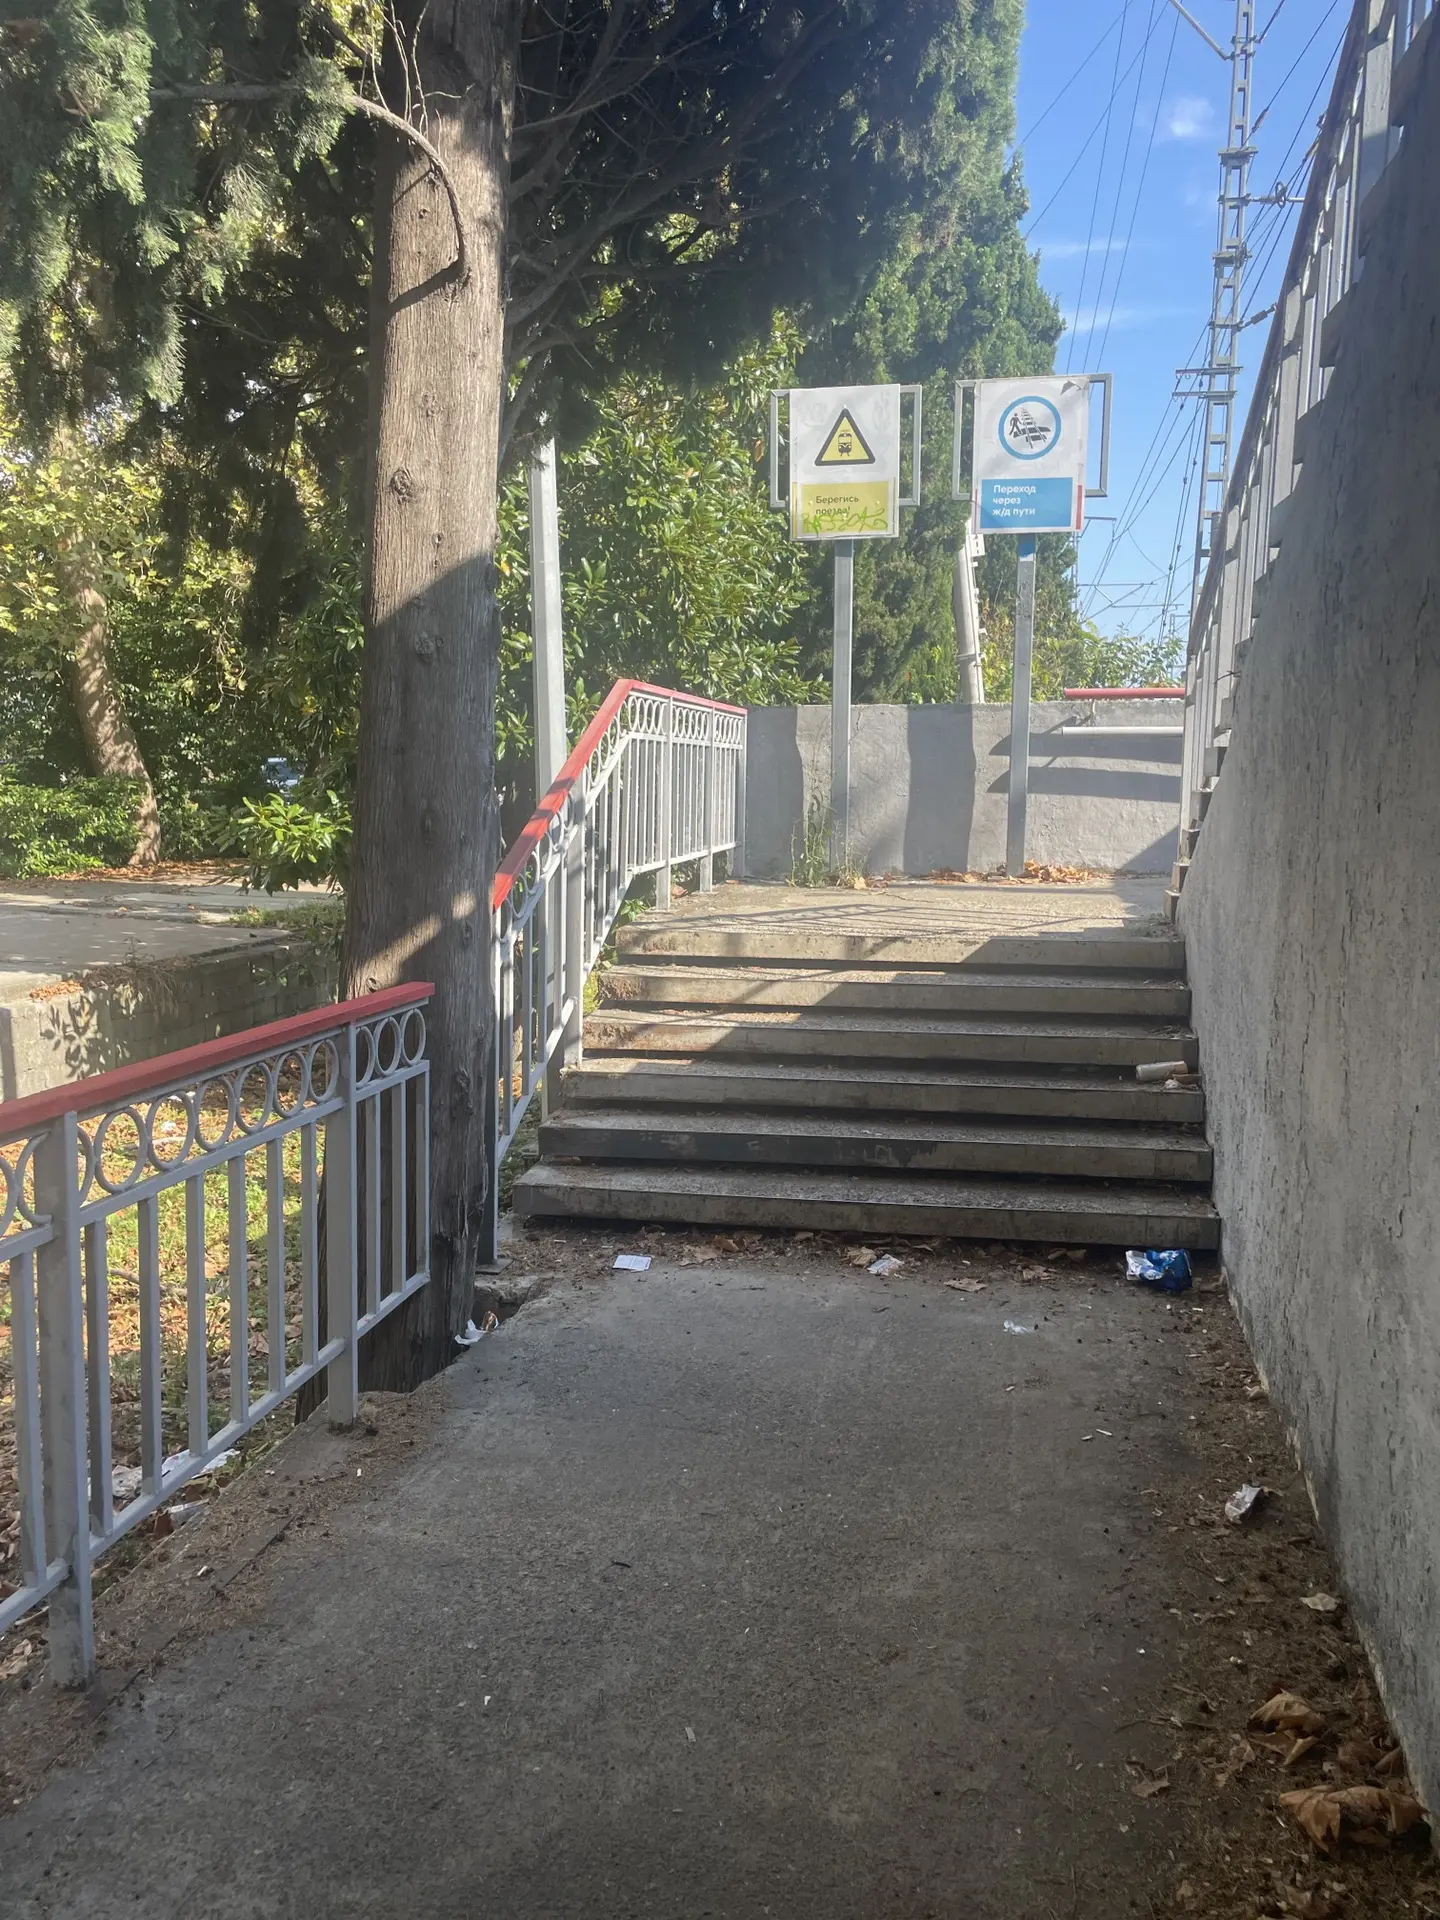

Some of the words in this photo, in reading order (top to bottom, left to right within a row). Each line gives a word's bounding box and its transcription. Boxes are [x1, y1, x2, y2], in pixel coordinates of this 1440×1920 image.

[993, 485, 1036, 495] Переход
[815, 495, 859, 505] Берегись
[815, 506, 851, 516] поезда!
[992, 507, 1011, 517] ж/д
[1013, 508, 1035, 517] пути
